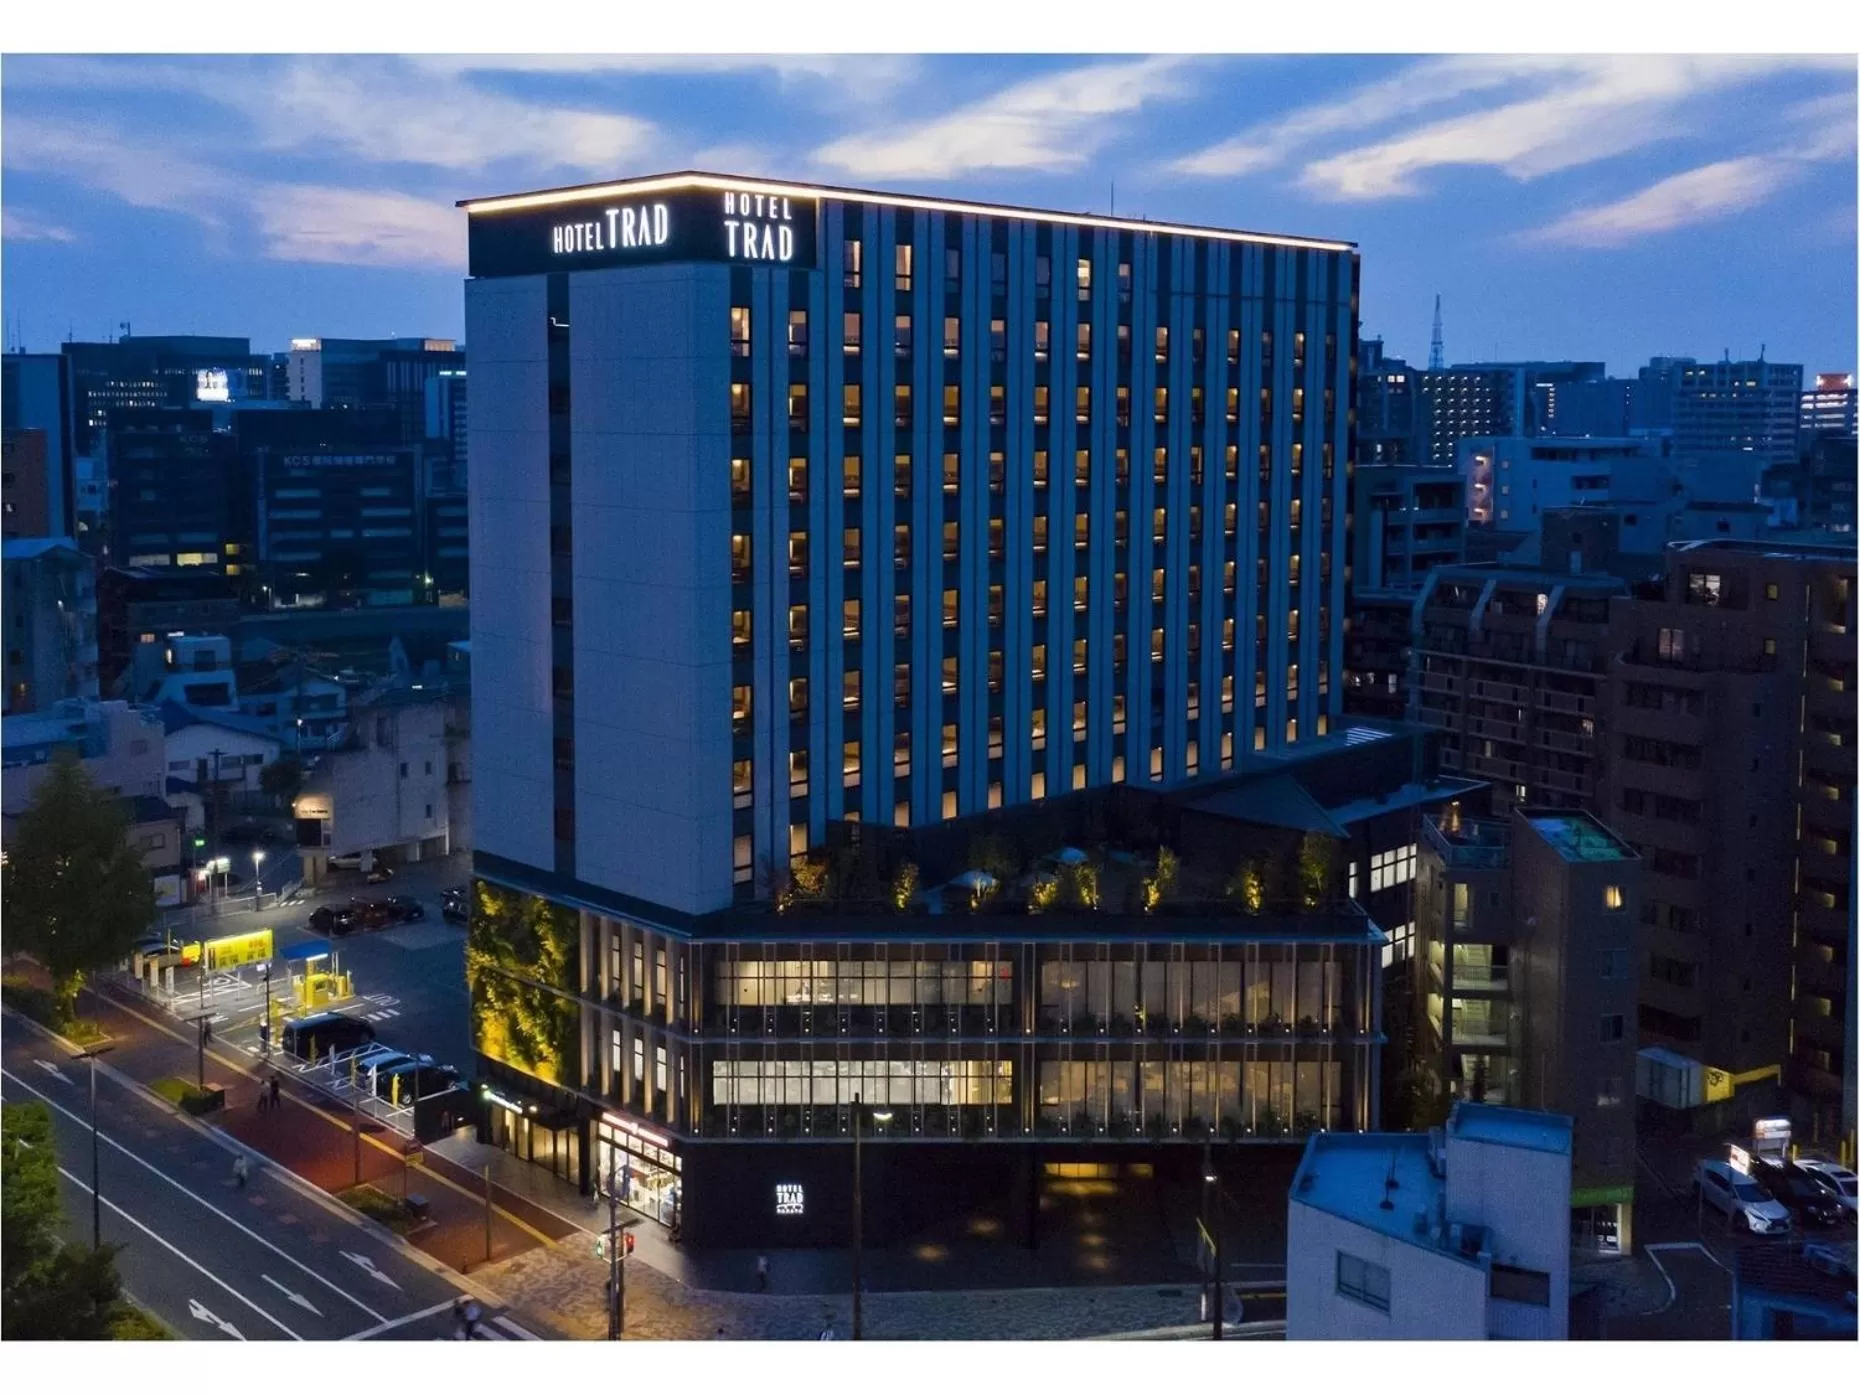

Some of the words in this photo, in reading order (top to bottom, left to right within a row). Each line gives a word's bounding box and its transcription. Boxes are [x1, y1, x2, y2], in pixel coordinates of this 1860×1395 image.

[724, 192, 792, 220] HOTEL
[552, 222, 605, 254] HOTEL
[605, 203, 669, 249] TRAD
[724, 220, 794, 262] TRAD
[776, 1184, 804, 1193] HOTEL
[776, 1192, 804, 1204] TRAD
